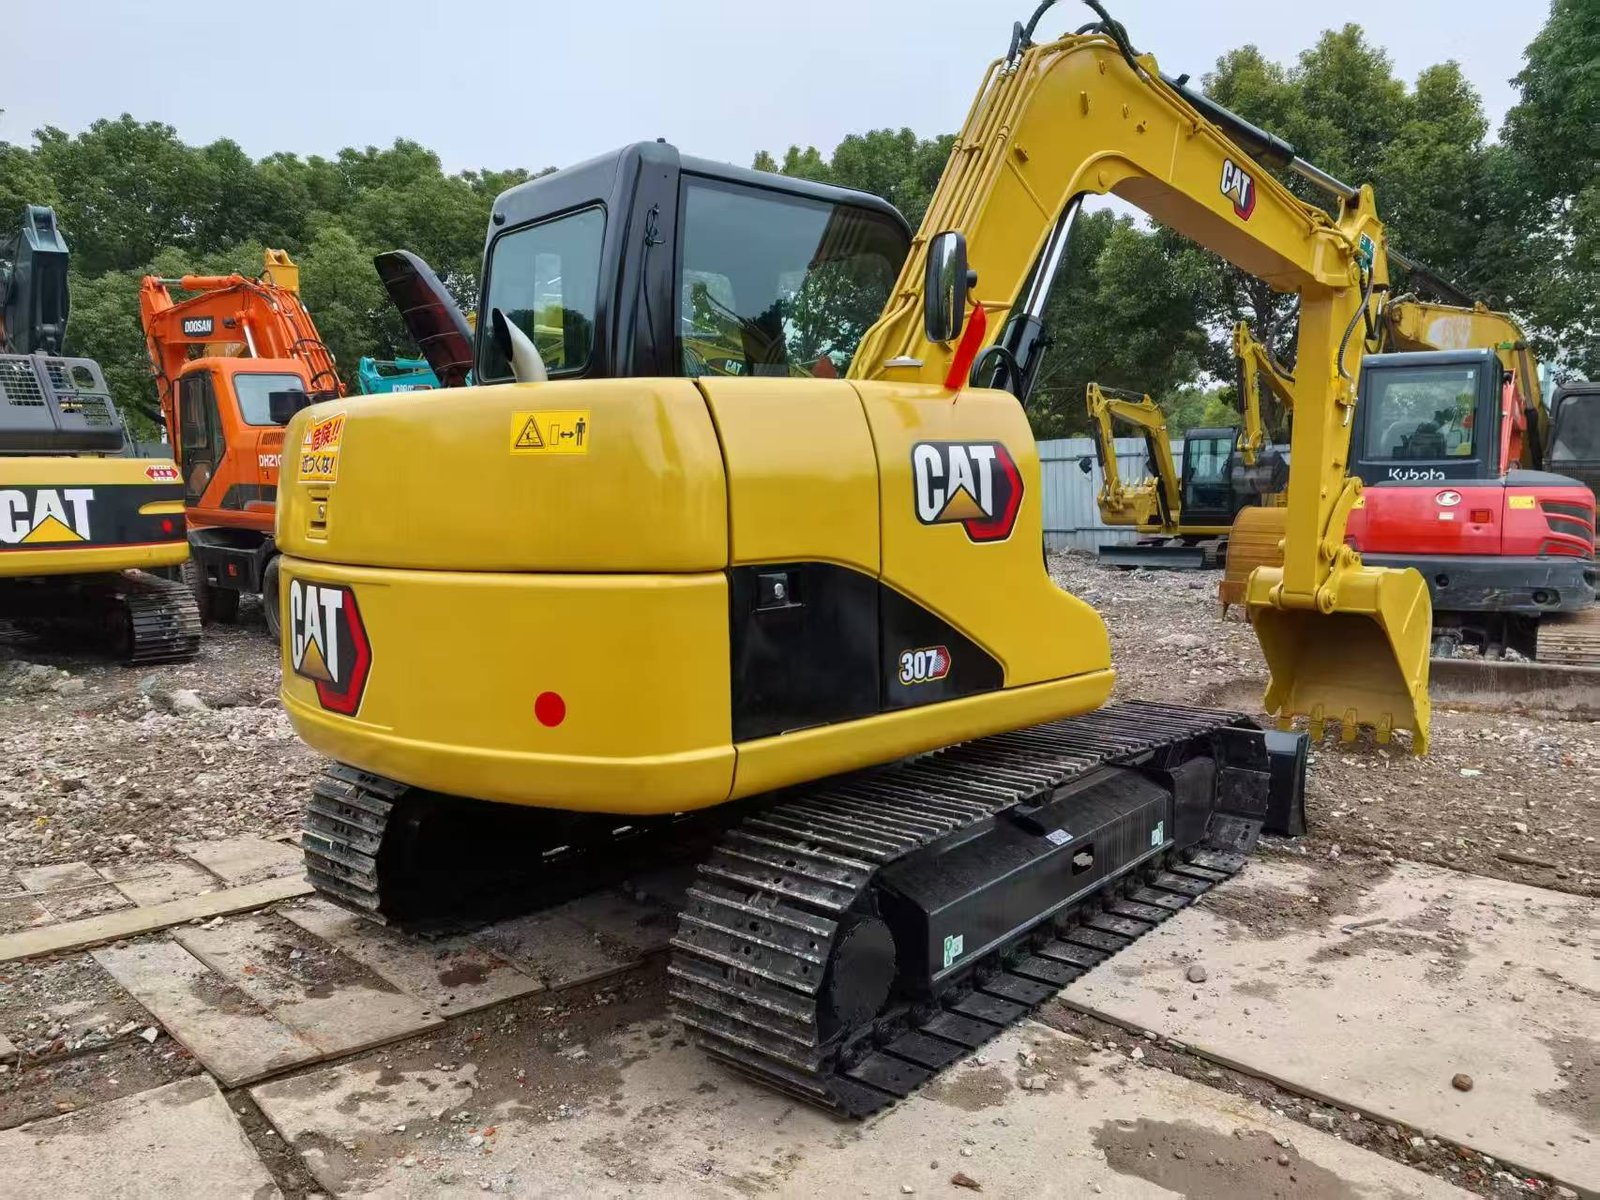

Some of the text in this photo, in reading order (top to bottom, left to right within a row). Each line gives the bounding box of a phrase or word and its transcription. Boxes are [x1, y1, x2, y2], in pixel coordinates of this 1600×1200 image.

[1221, 159, 1251, 209] CAT
[184, 320, 212, 333] DOOSAN
[725, 359, 743, 376] CAT
[914, 444, 996, 522] CAT
[1388, 468, 1446, 480] Kubota
[0, 488, 95, 544] CAT
[290, 580, 343, 683] CAT
[901, 649, 938, 681] 307
